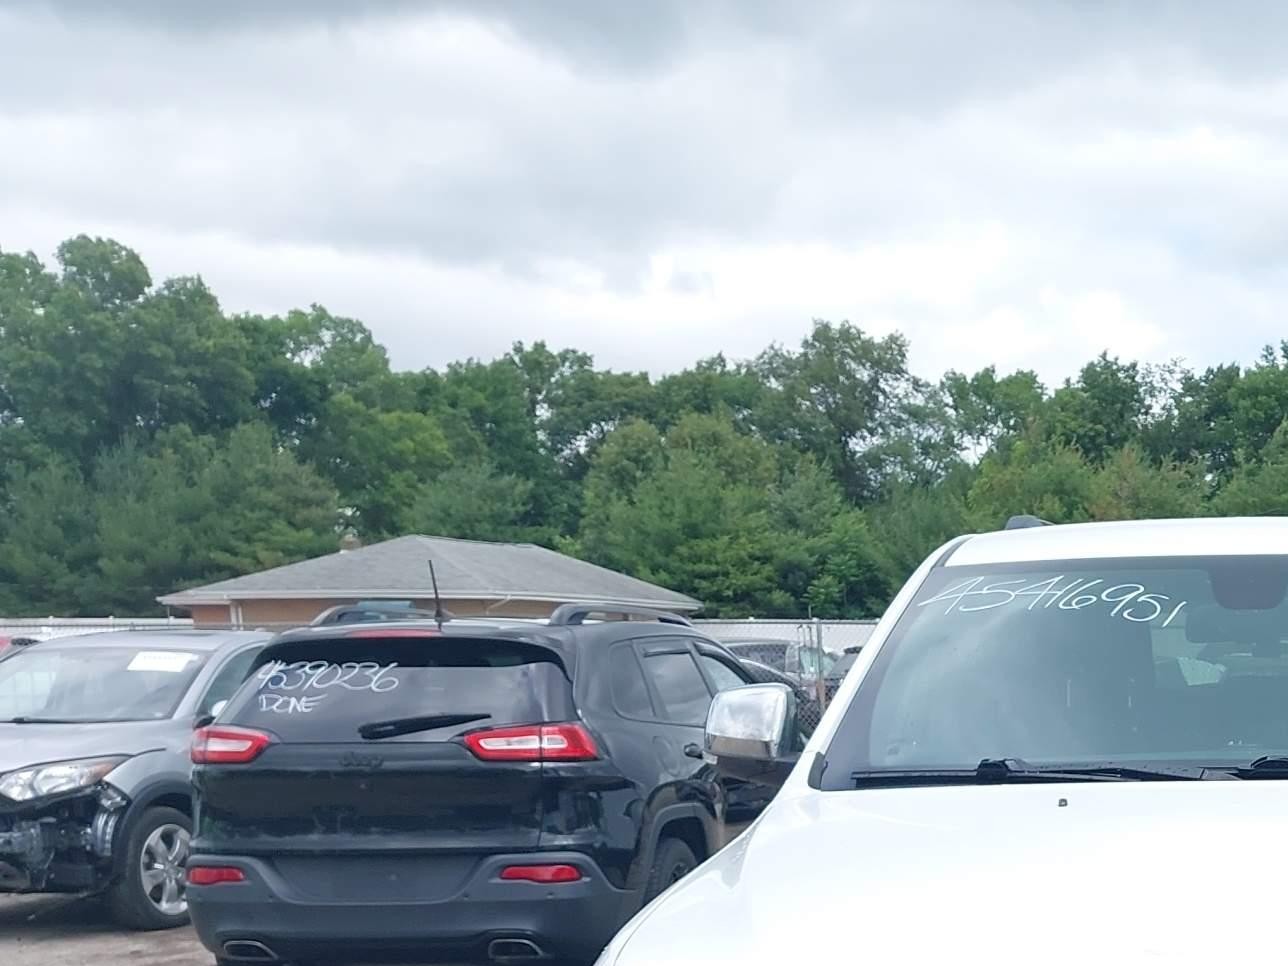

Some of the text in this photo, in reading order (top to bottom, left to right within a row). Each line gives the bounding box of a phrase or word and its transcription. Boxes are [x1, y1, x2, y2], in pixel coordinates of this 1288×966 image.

[917, 575, 1188, 628] 45416951
[257, 659, 400, 693] 45390236
[258, 693, 329, 714] DONE
